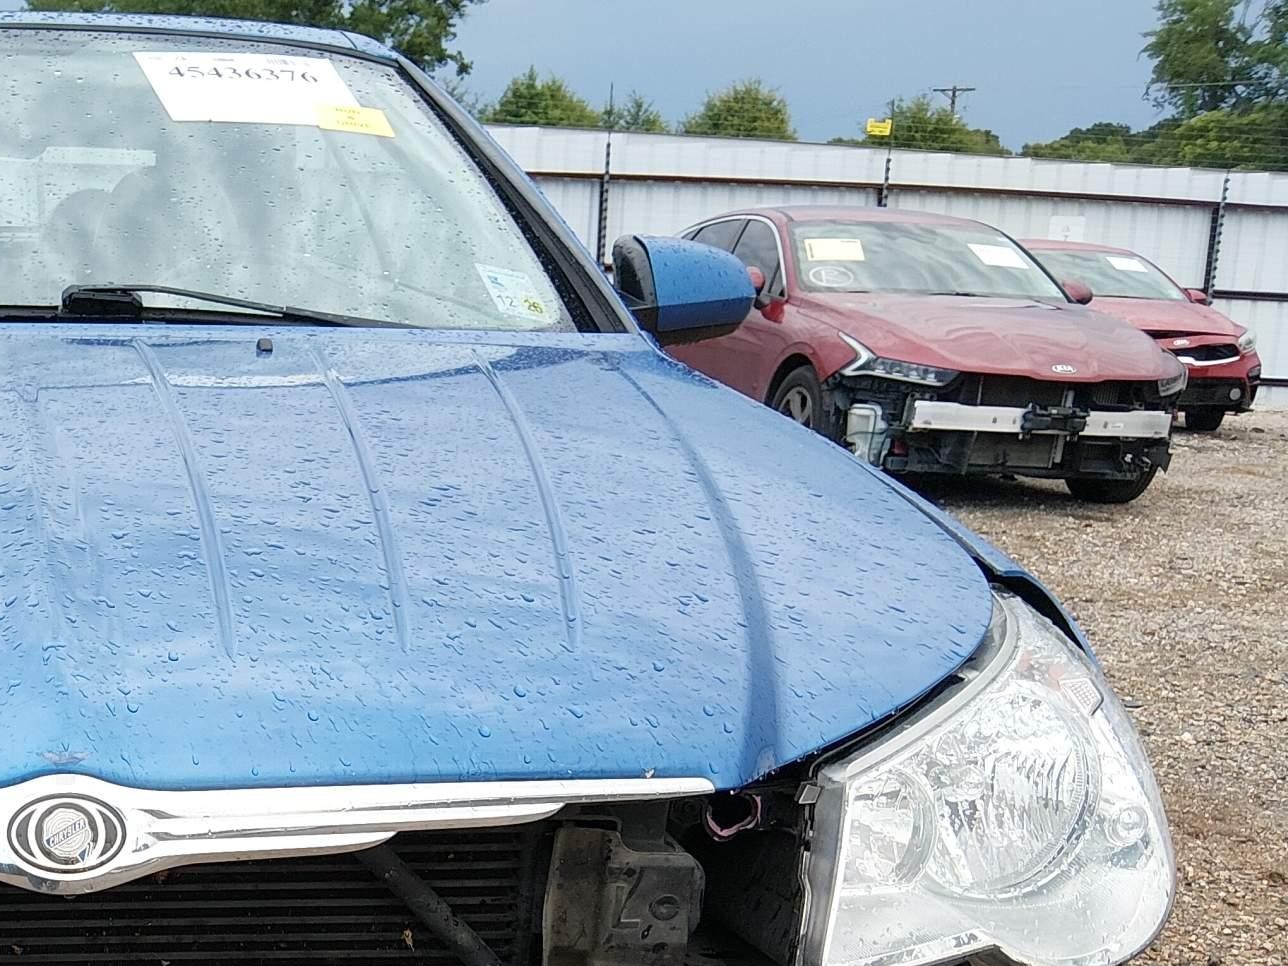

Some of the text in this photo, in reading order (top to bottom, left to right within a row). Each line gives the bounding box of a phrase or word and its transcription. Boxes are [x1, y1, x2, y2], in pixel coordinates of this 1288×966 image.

[168, 65, 319, 83] 45436376
[496, 294, 517, 308] 12
[1053, 363, 1075, 374] KIA
[49, 817, 88, 849] CHRYSLER
